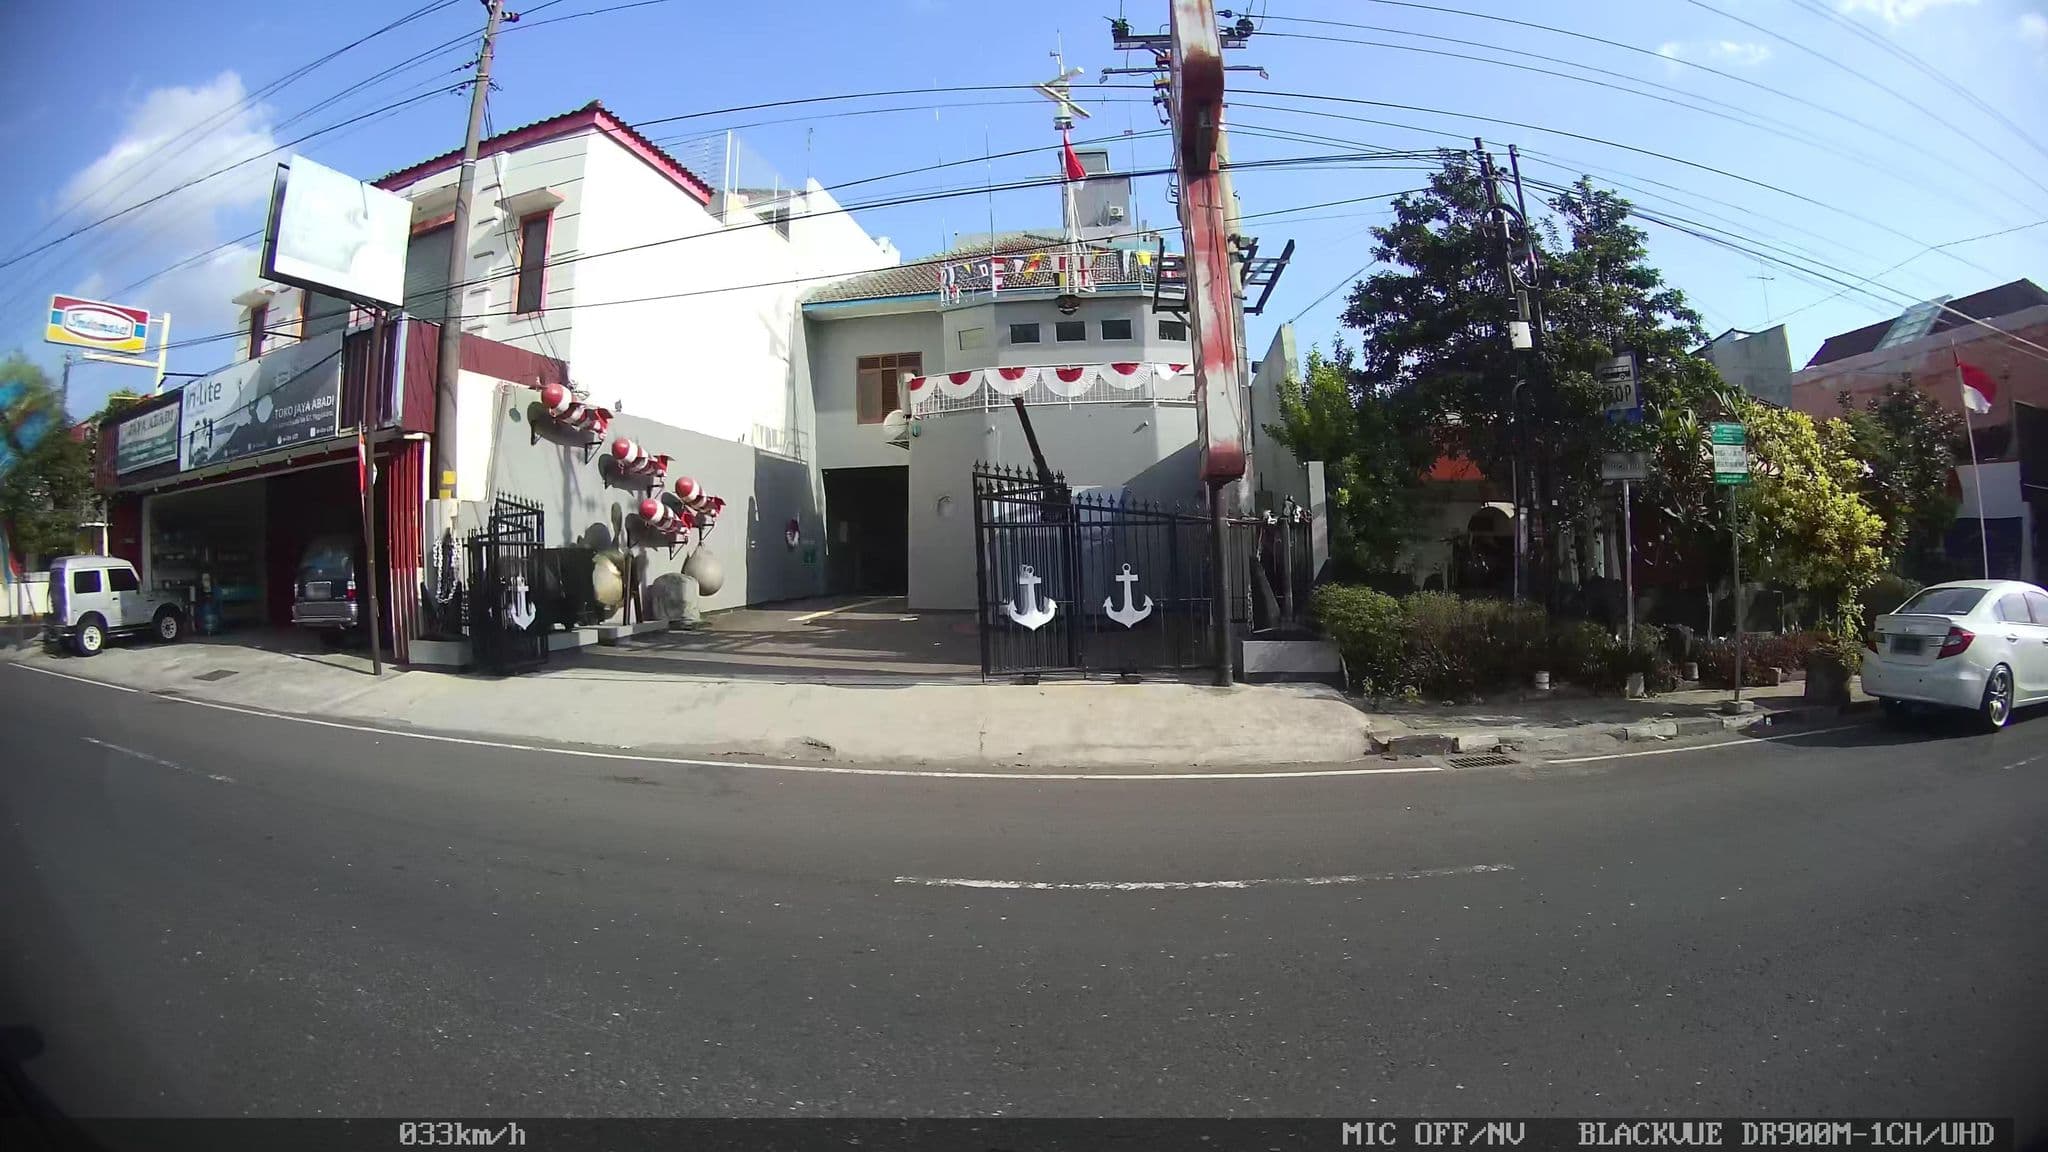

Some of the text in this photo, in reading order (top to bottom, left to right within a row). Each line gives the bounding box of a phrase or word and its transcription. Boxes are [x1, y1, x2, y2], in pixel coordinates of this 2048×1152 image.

[275, 406, 293, 420] TOKO
[293, 400, 311, 417] JAYA
[311, 395, 335, 411] ABADI
